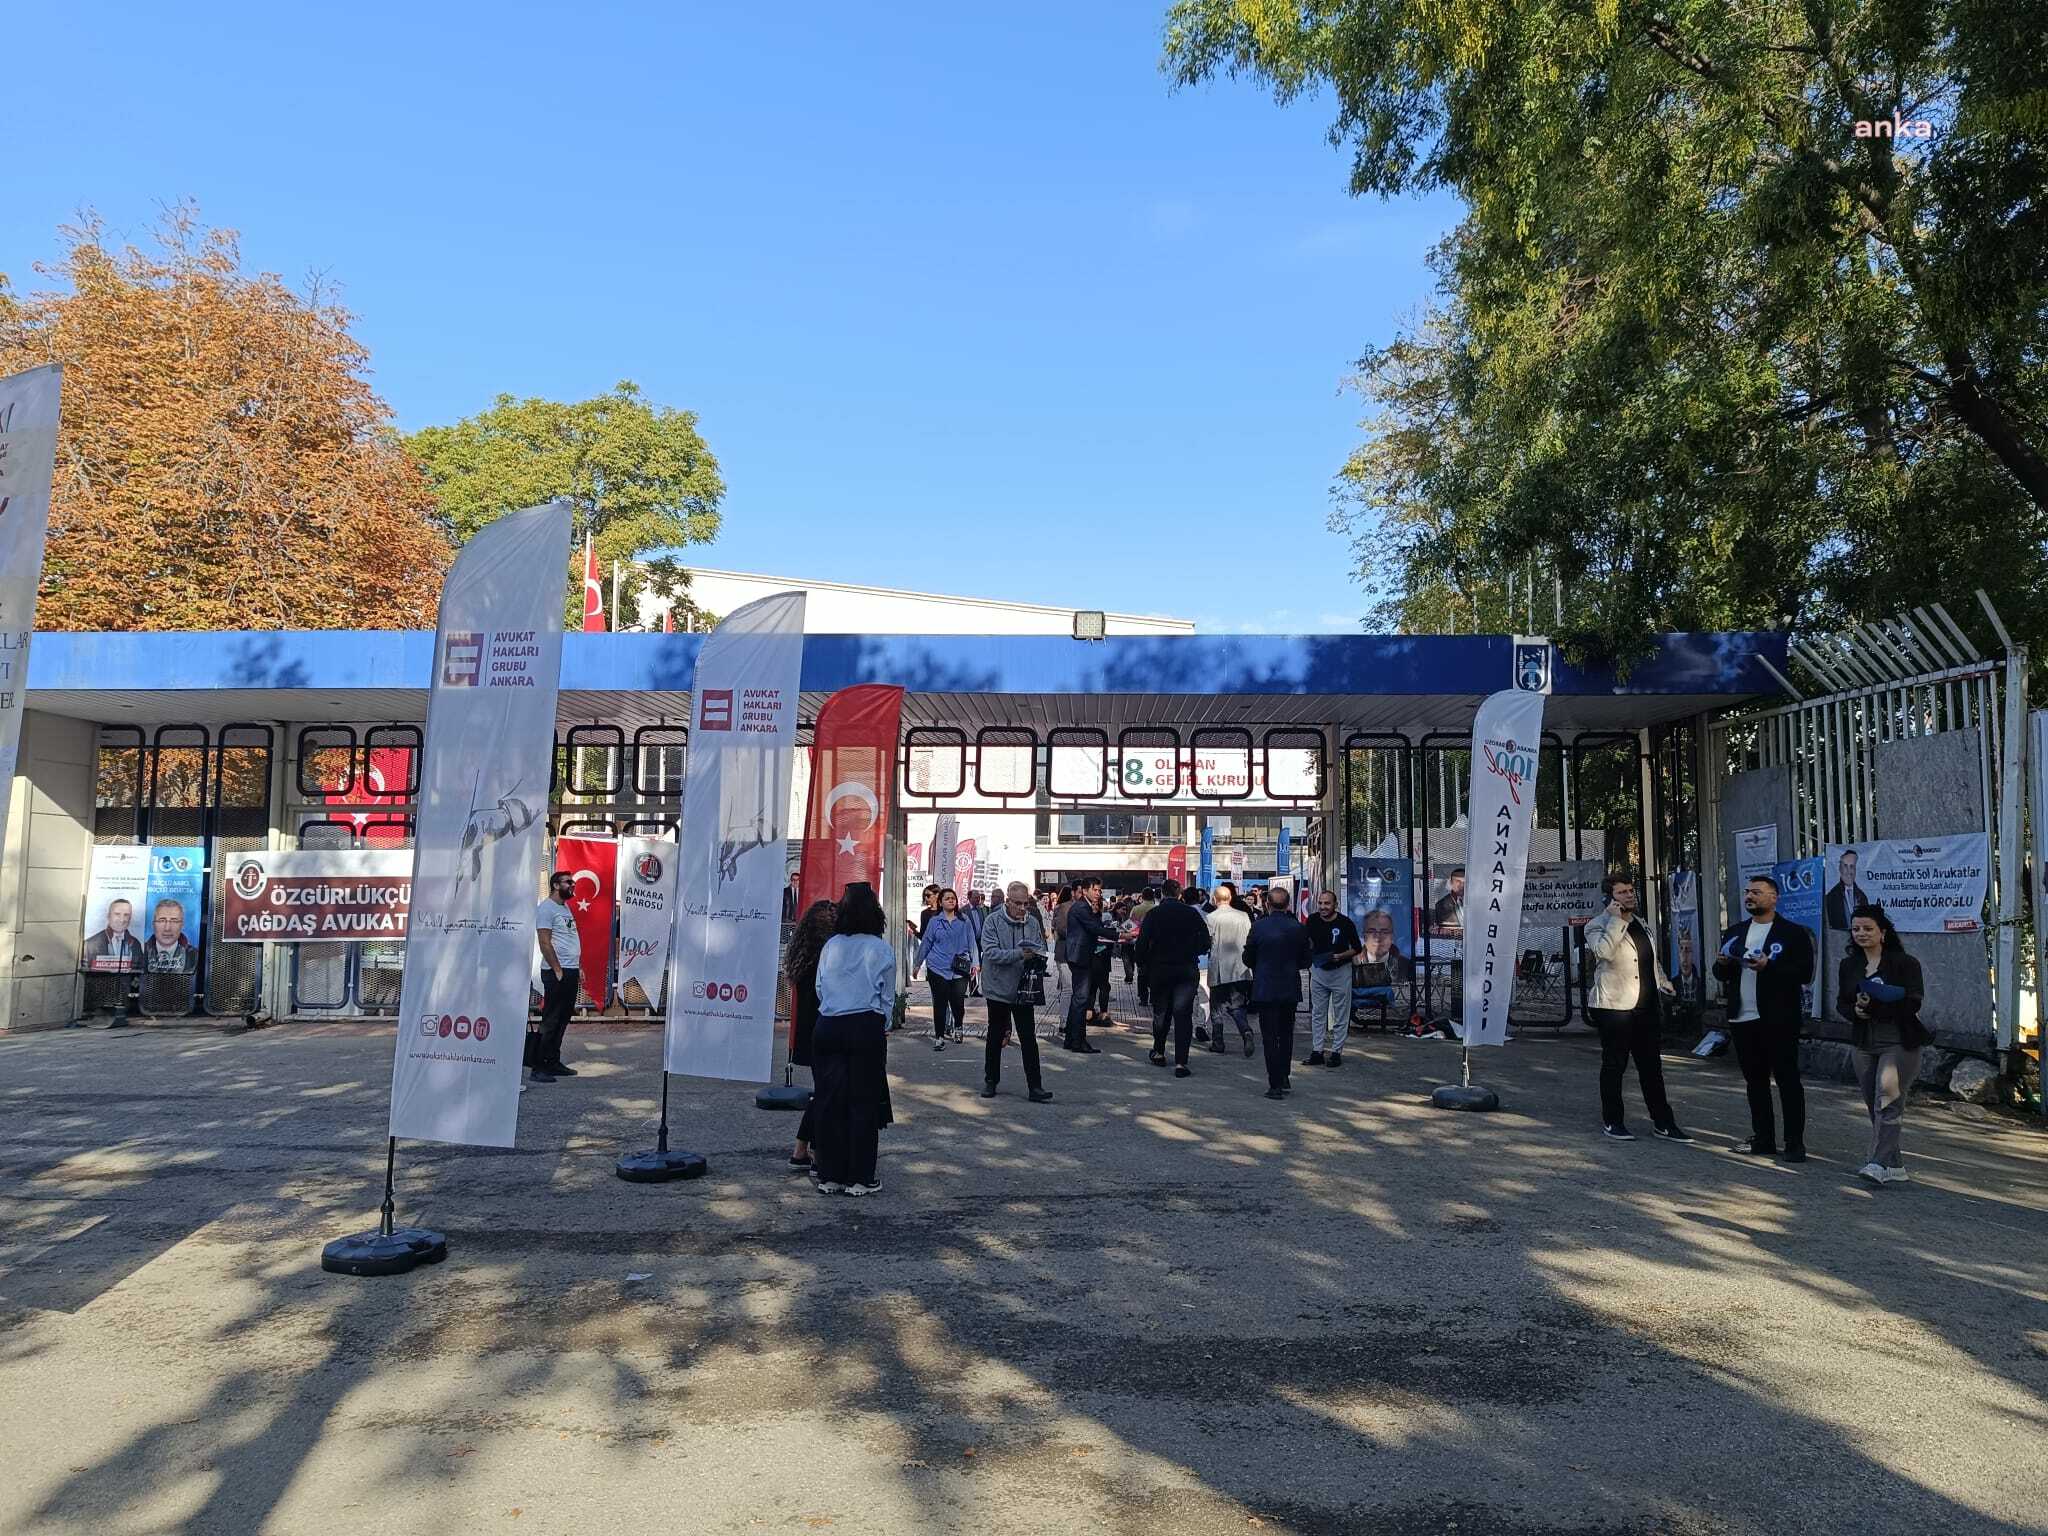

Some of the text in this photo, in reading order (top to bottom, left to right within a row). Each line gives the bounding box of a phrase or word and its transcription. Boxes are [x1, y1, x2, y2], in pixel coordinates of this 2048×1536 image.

[494, 632, 535, 642] AVUKAT
[492, 646, 539, 657] HAKLARI
[491, 661, 526, 671] GRUBU
[489, 676, 534, 687] ANKARA
[743, 689, 779, 698] AVUKAT
[743, 701, 782, 710] HAKLARI
[742, 713, 773, 721] GRUBU
[740, 724, 778, 733] ANKARA
[1867, 866, 1981, 880] Demokratik Sol Avukatlar
[270, 885, 412, 909] ÖZGÜRLÜKÇÜ
[626, 886, 664, 901] ANKARA
[625, 896, 663, 910] BAROSU
[1546, 899, 1594, 911] KÖROĞLU
[1890, 896, 1922, 911] Mustafa
[1923, 894, 1974, 908] KÖROĞLU
[237, 910, 316, 936] ÇAĞDAŞ
[322, 912, 408, 932] AVUKAT
